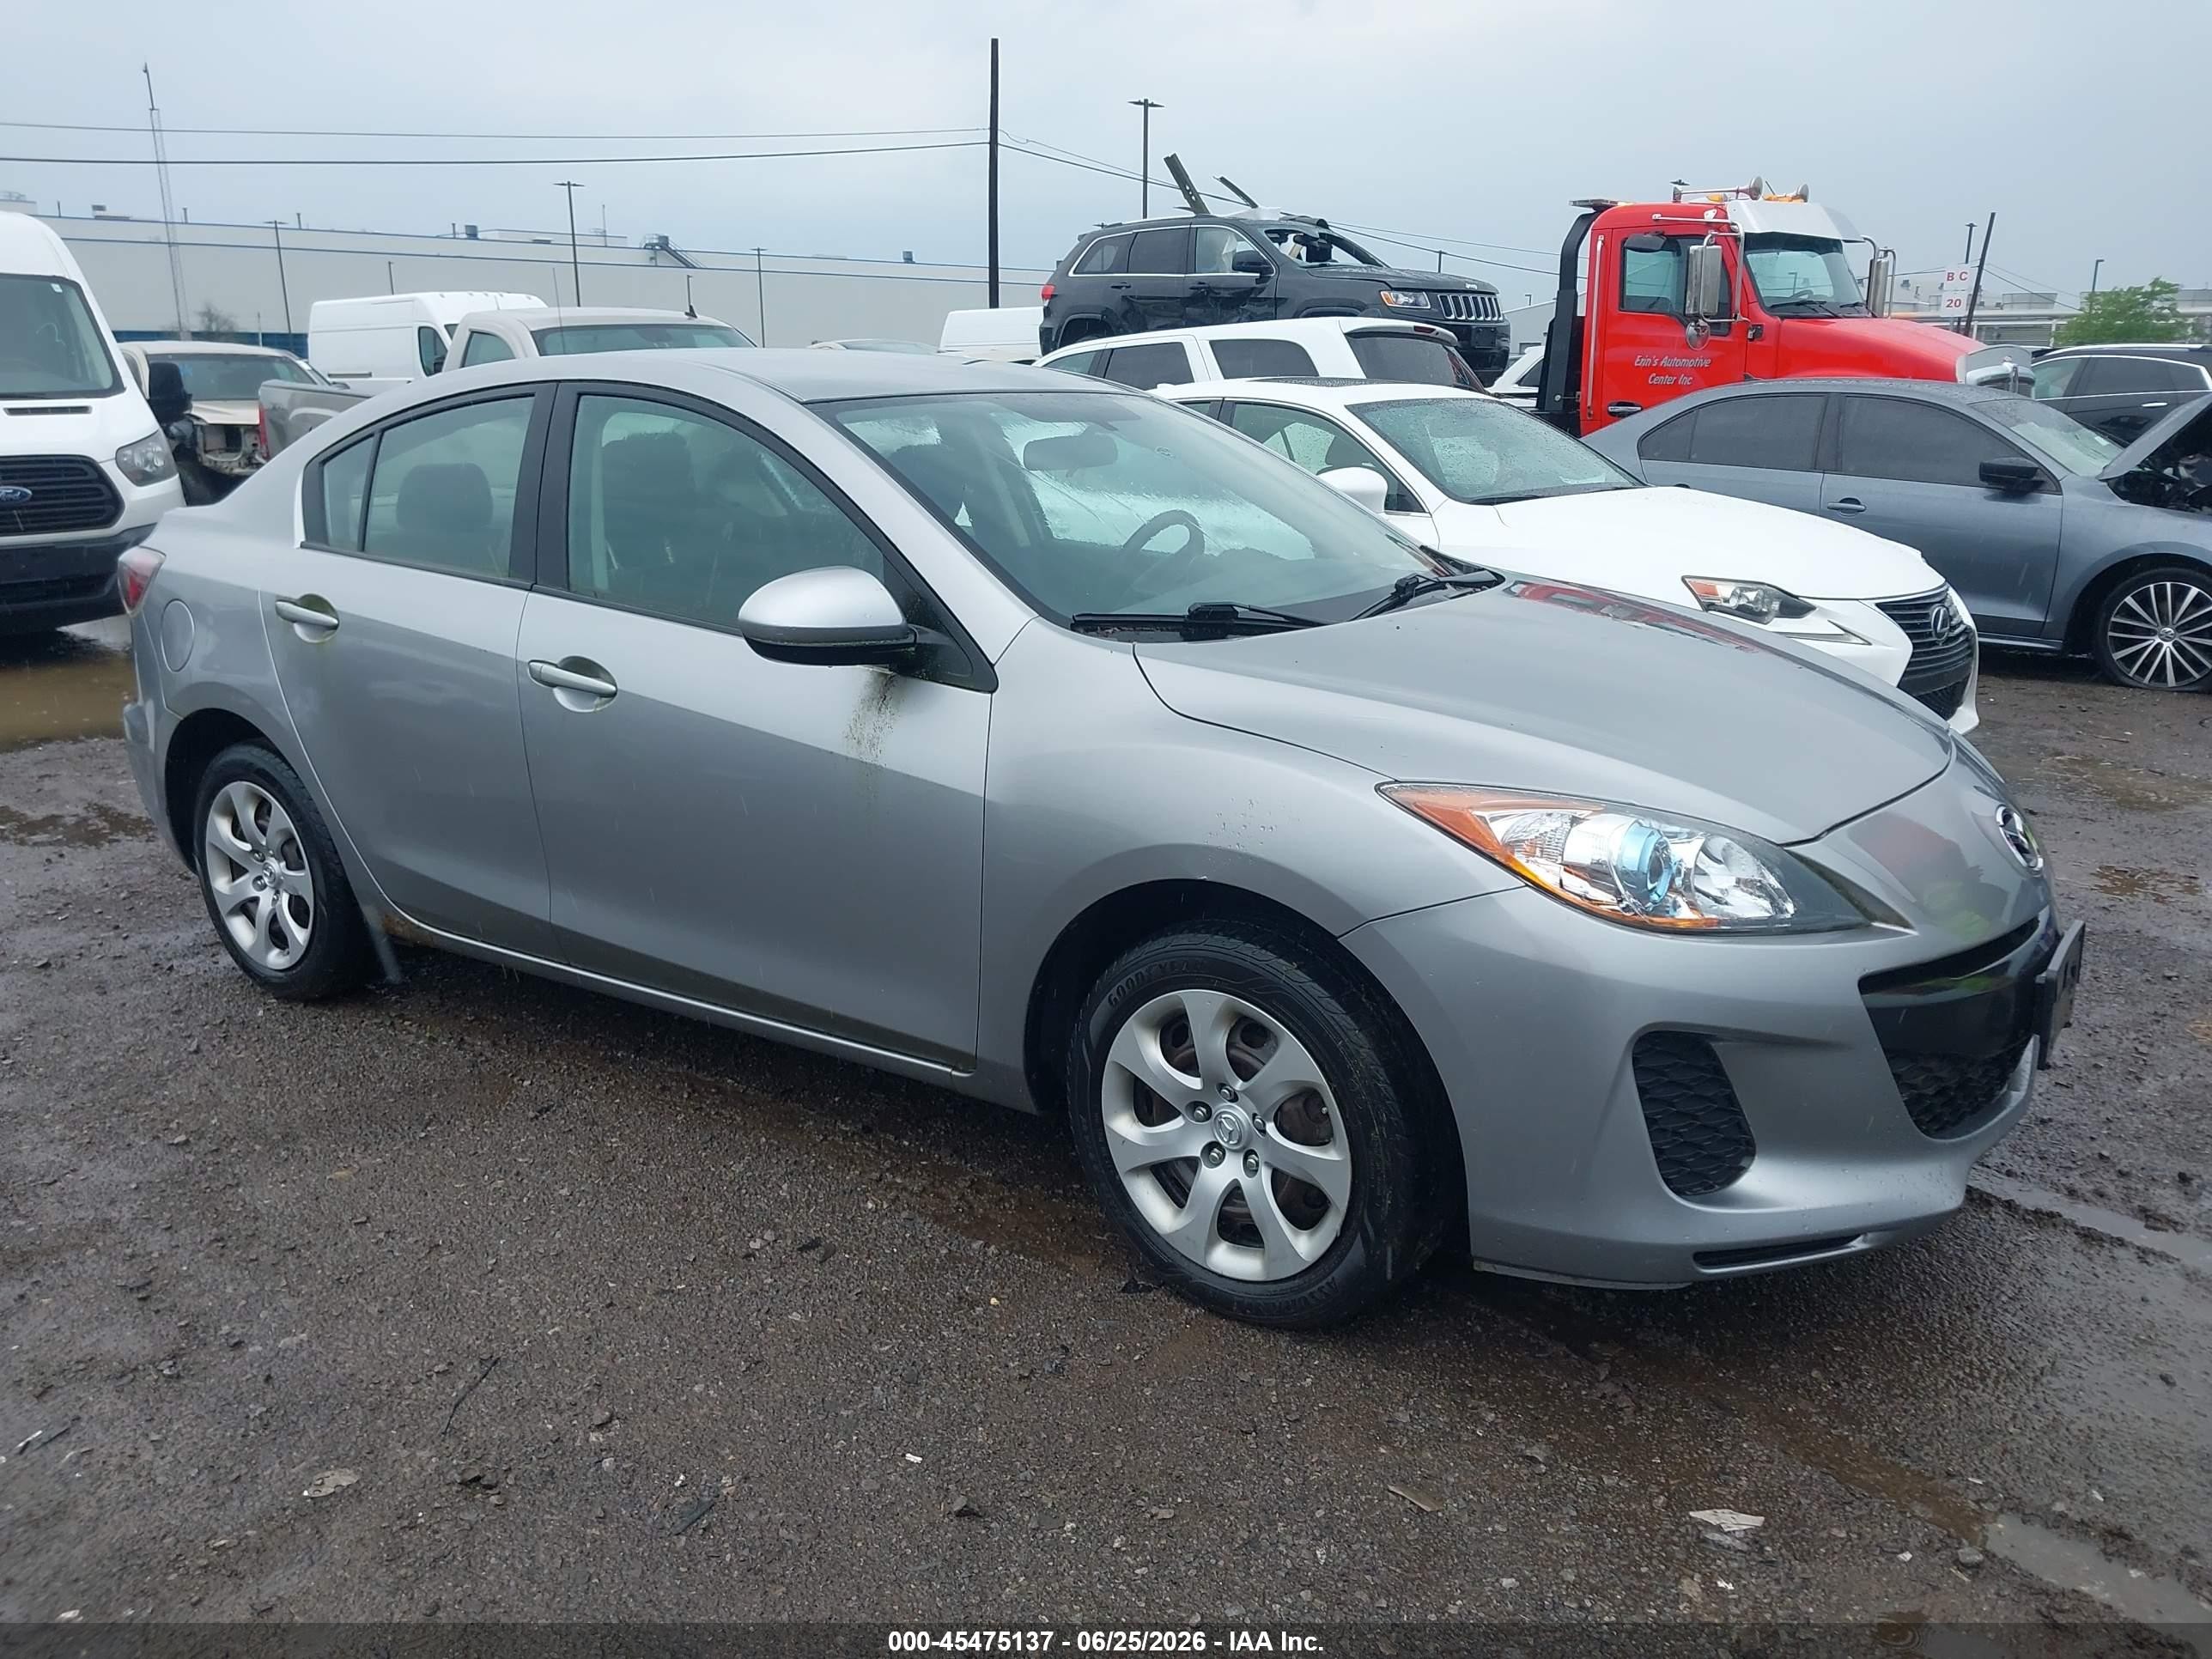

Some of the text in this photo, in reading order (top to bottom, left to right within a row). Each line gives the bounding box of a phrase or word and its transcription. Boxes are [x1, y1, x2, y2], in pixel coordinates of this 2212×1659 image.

[1946, 271, 1968, 282] B C
[1945, 298, 1962, 308] 20
[1661, 355, 1711, 368] Automotive
[1649, 373, 1693, 385] Center Inc
